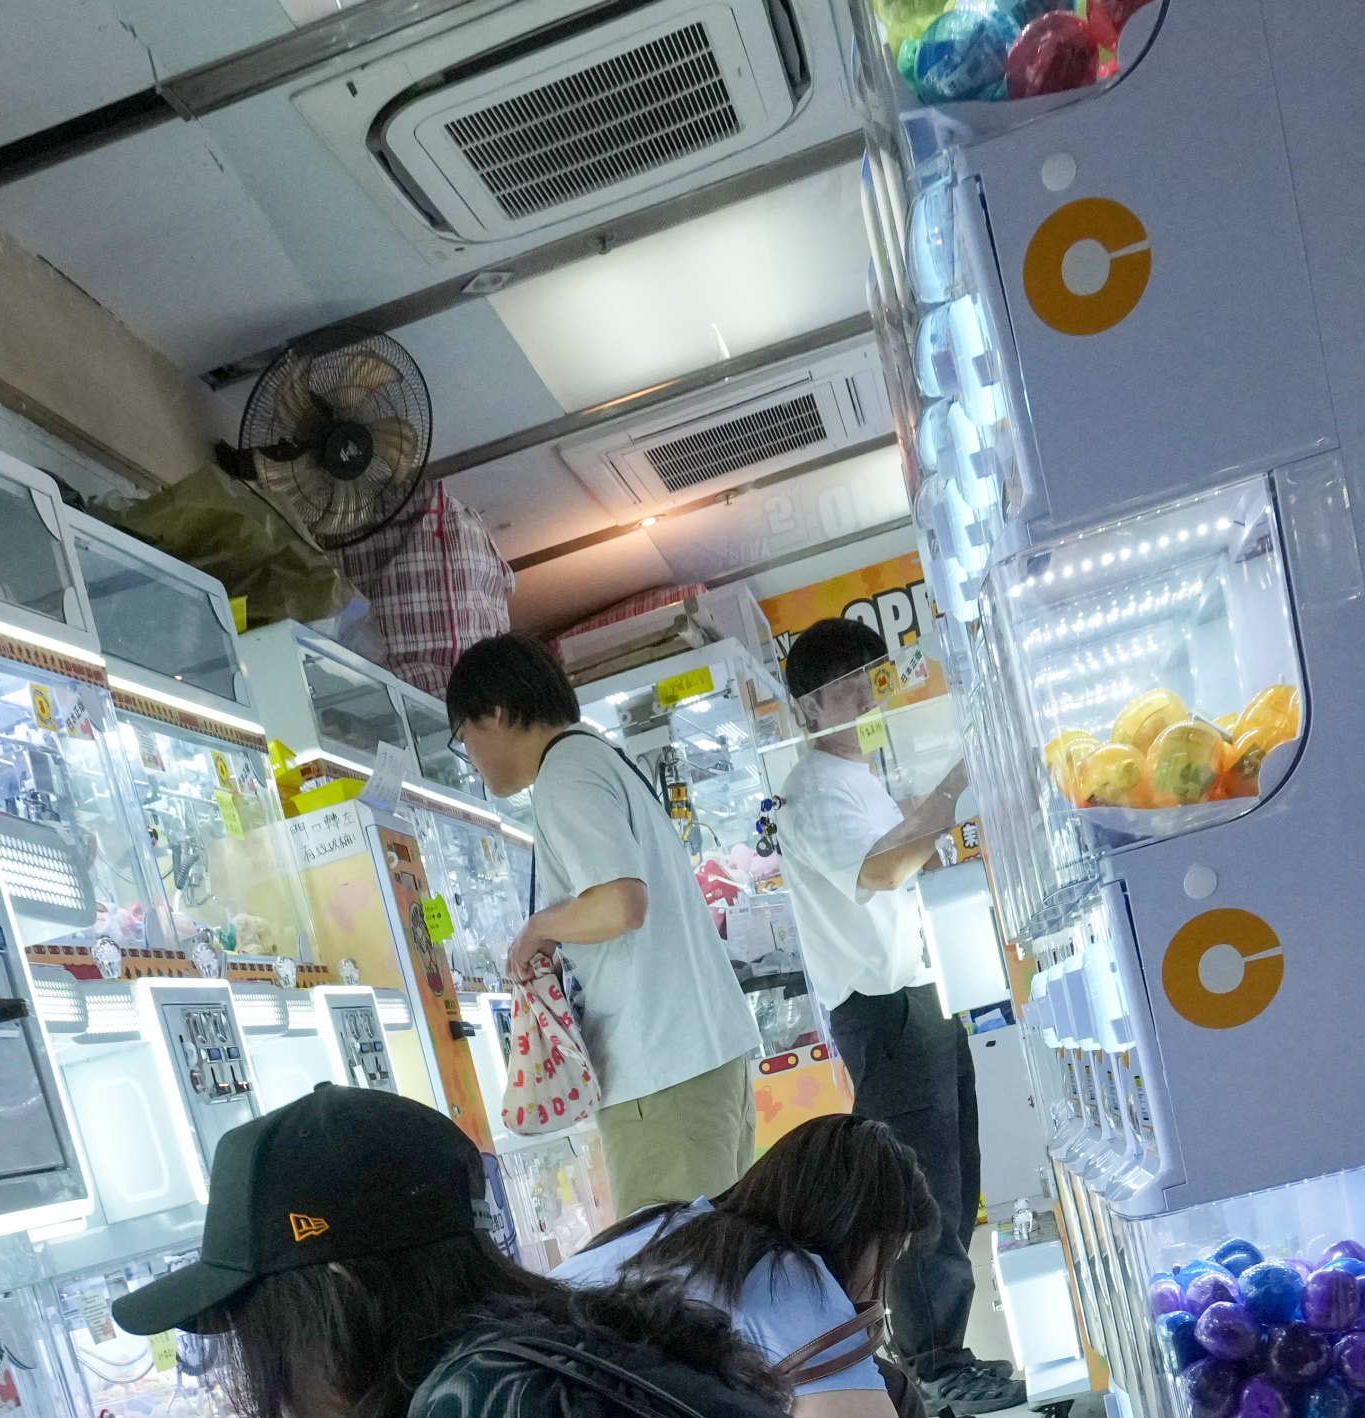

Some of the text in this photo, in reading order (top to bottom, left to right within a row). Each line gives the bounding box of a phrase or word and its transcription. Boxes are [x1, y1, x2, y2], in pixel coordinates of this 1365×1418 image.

[900, 650, 923, 686] 日本正版
[289, 811, 355, 840] 門口轉左
